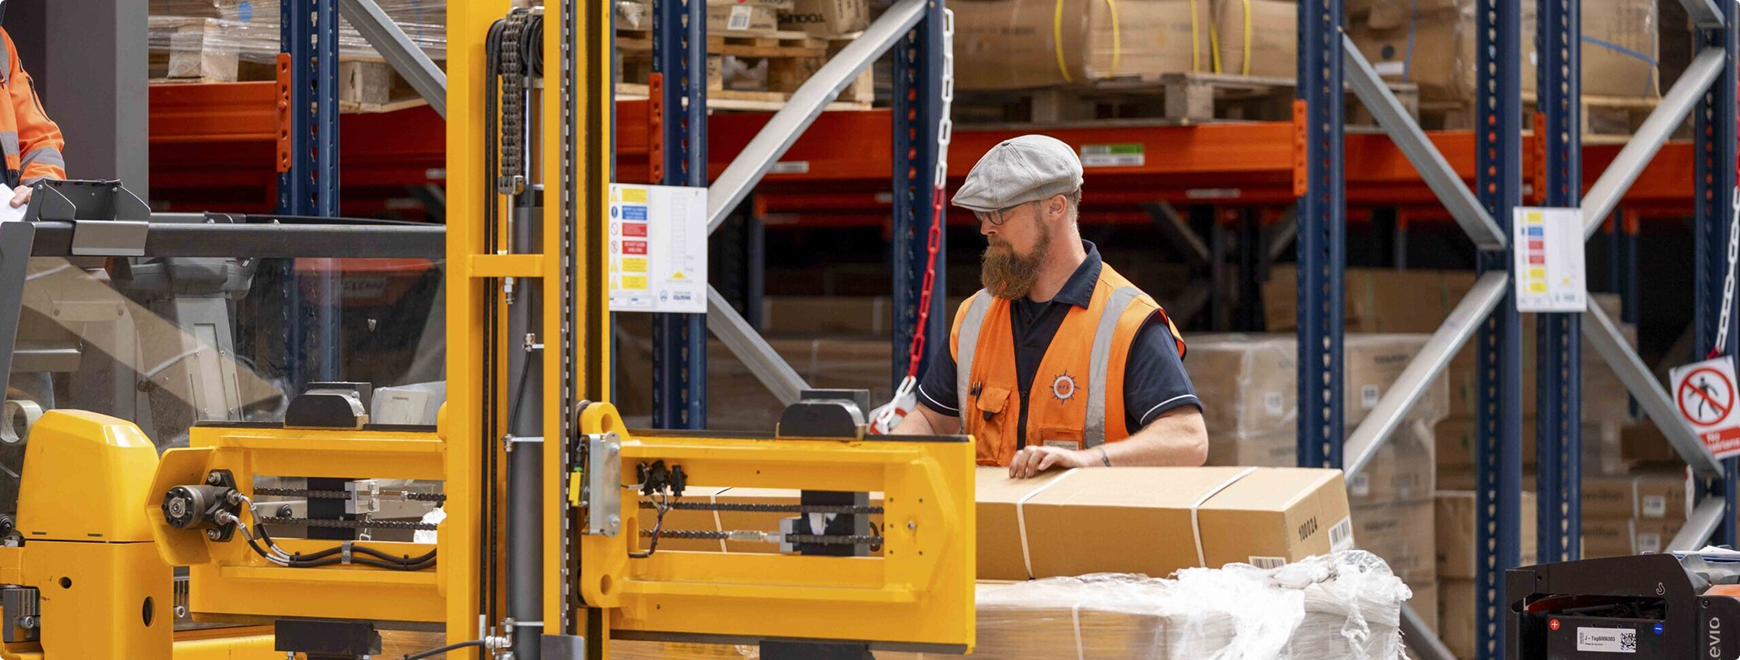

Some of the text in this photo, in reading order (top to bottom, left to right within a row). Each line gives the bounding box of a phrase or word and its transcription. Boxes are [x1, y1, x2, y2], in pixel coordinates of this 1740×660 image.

[1706, 431, 1721, 444] No
[1298, 515, 1318, 542] 100024
[1709, 616, 1721, 660] evio
